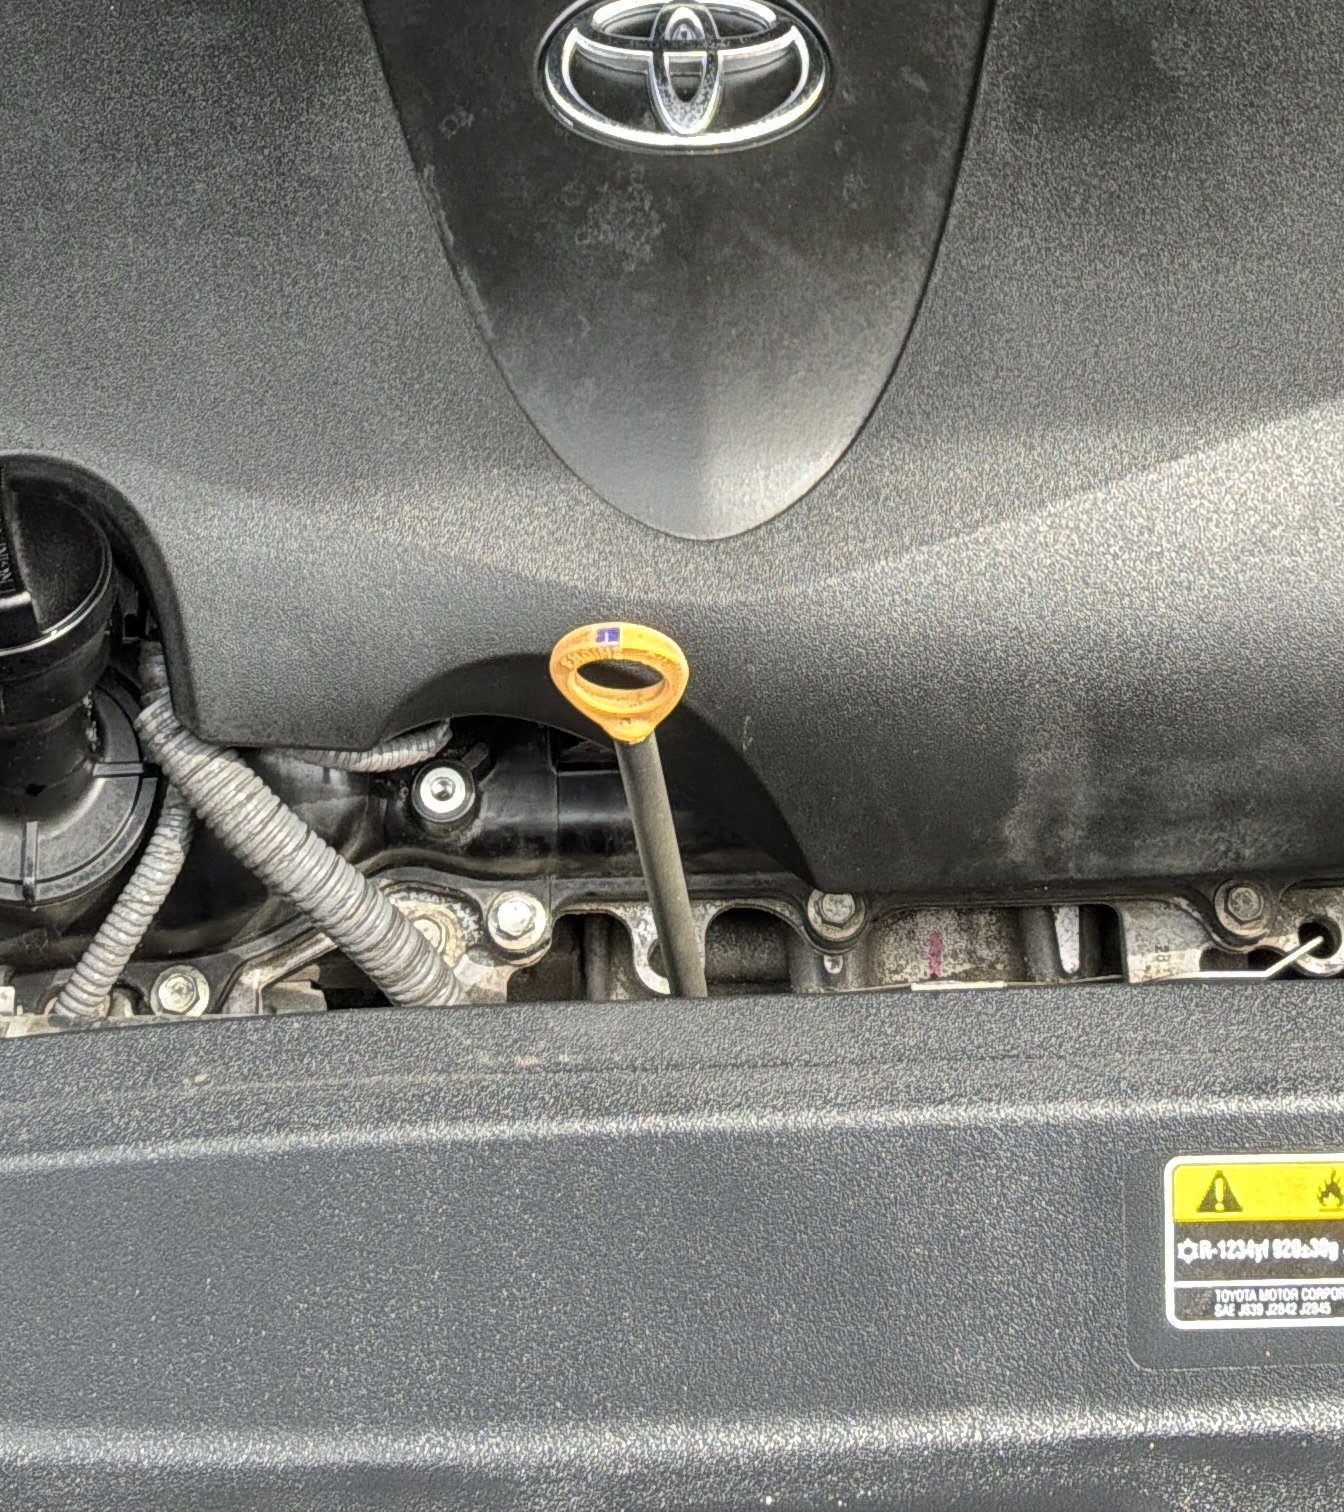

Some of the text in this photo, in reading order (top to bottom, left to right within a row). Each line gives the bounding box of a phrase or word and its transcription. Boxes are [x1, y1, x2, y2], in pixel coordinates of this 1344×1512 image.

[1214, 1288, 1256, 1303] TOYOTA
[1258, 1288, 1299, 1302] MOTOR
[1213, 1303, 1236, 1317] SAE
